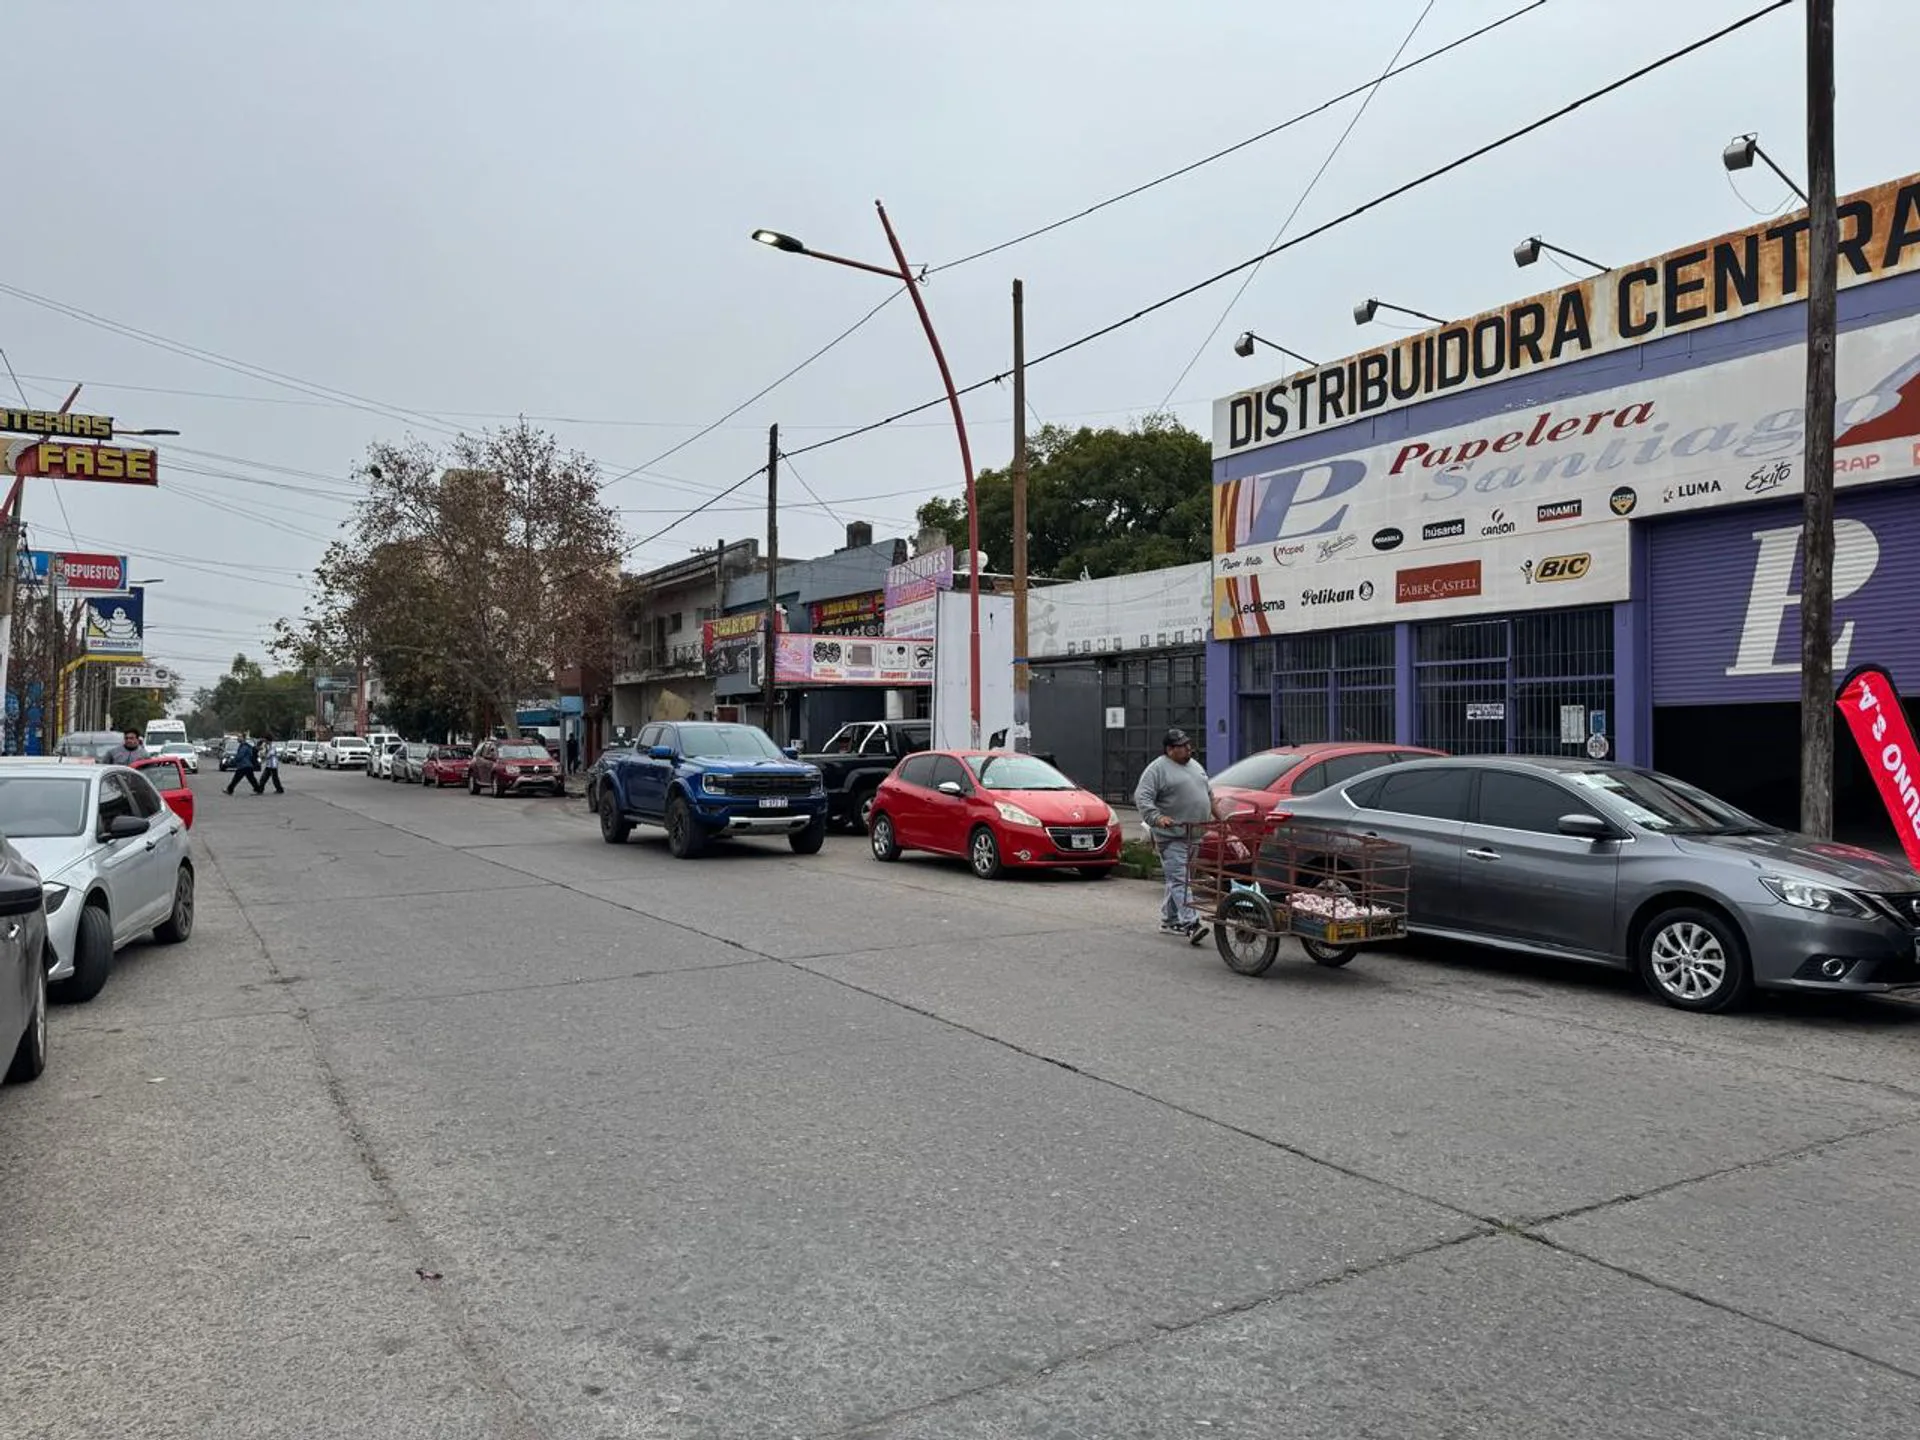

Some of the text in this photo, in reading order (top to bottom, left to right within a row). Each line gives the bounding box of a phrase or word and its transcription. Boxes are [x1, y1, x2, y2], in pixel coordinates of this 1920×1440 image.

[1230, 289, 1592, 450] DISTRIBUIDORA
[1388, 400, 1656, 476] Papelera
[39, 444, 150, 478] FASE
[1678, 480, 1722, 498] LUMA
[1538, 503, 1580, 518] DINAMIT
[64, 562, 120, 580] REPUESTOS
[1301, 587, 1355, 607] Pelikan
[1399, 578, 1479, 598] FABER-CASTELL
